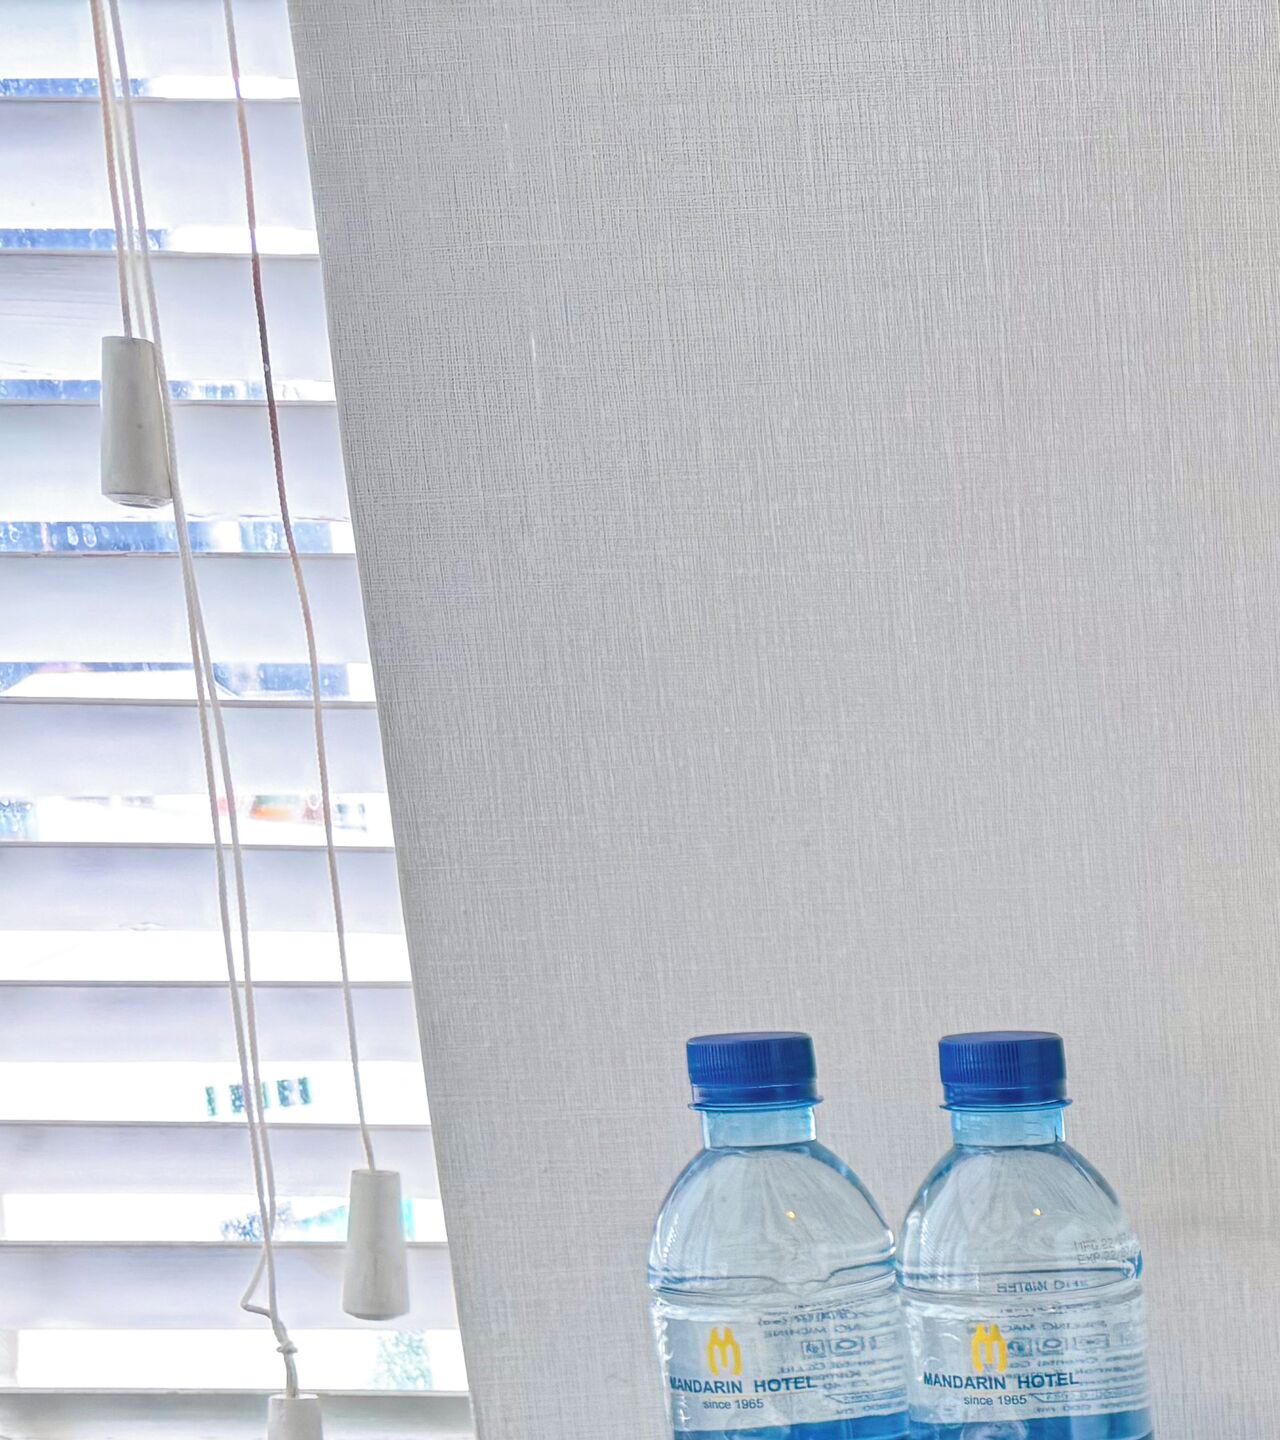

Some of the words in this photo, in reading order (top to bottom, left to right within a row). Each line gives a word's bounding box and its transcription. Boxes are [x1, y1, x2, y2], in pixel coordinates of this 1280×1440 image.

[670, 1376, 743, 1394] MANDARIN
[754, 1376, 818, 1393] HOTEL
[923, 1372, 1006, 1391] MANDARIN
[1018, 1372, 1079, 1389] HOTEL
[704, 1400, 732, 1410] since
[736, 1399, 764, 1410] 1965
[964, 1395, 993, 1406] since
[999, 1395, 1027, 1406] 1965
